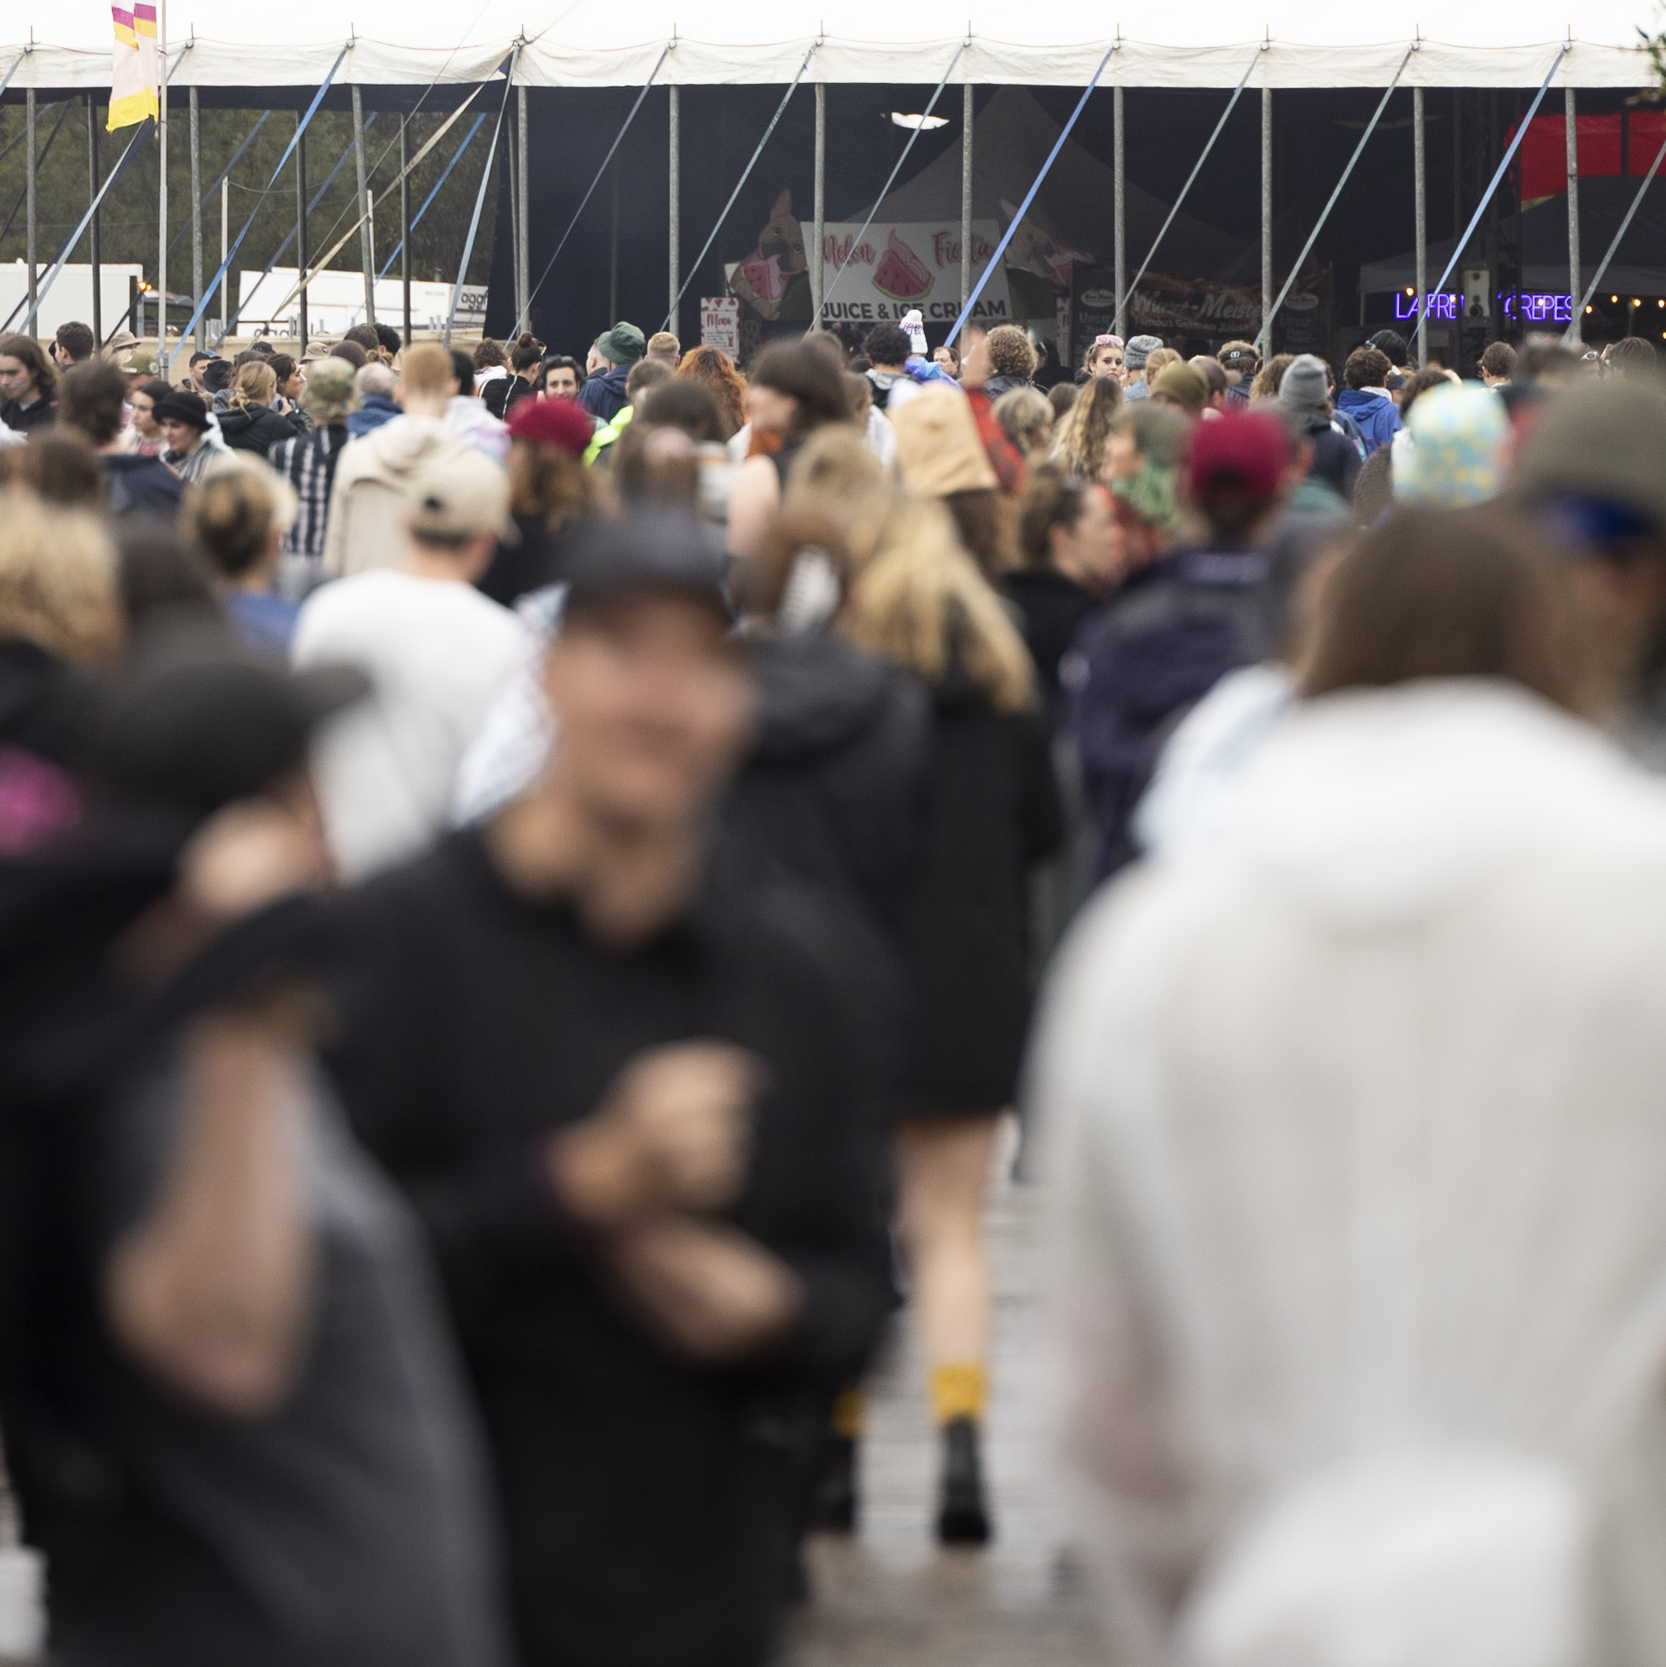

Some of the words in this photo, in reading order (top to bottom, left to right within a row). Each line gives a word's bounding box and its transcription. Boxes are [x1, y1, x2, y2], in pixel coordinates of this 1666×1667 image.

[932, 231, 992, 267] Fieta
[822, 302, 873, 319] JUICE
[878, 303, 890, 319] &
[894, 303, 924, 320] ICE
[929, 300, 1007, 319] CRAM
[1131, 289, 1263, 320] Wurst-Meiste
